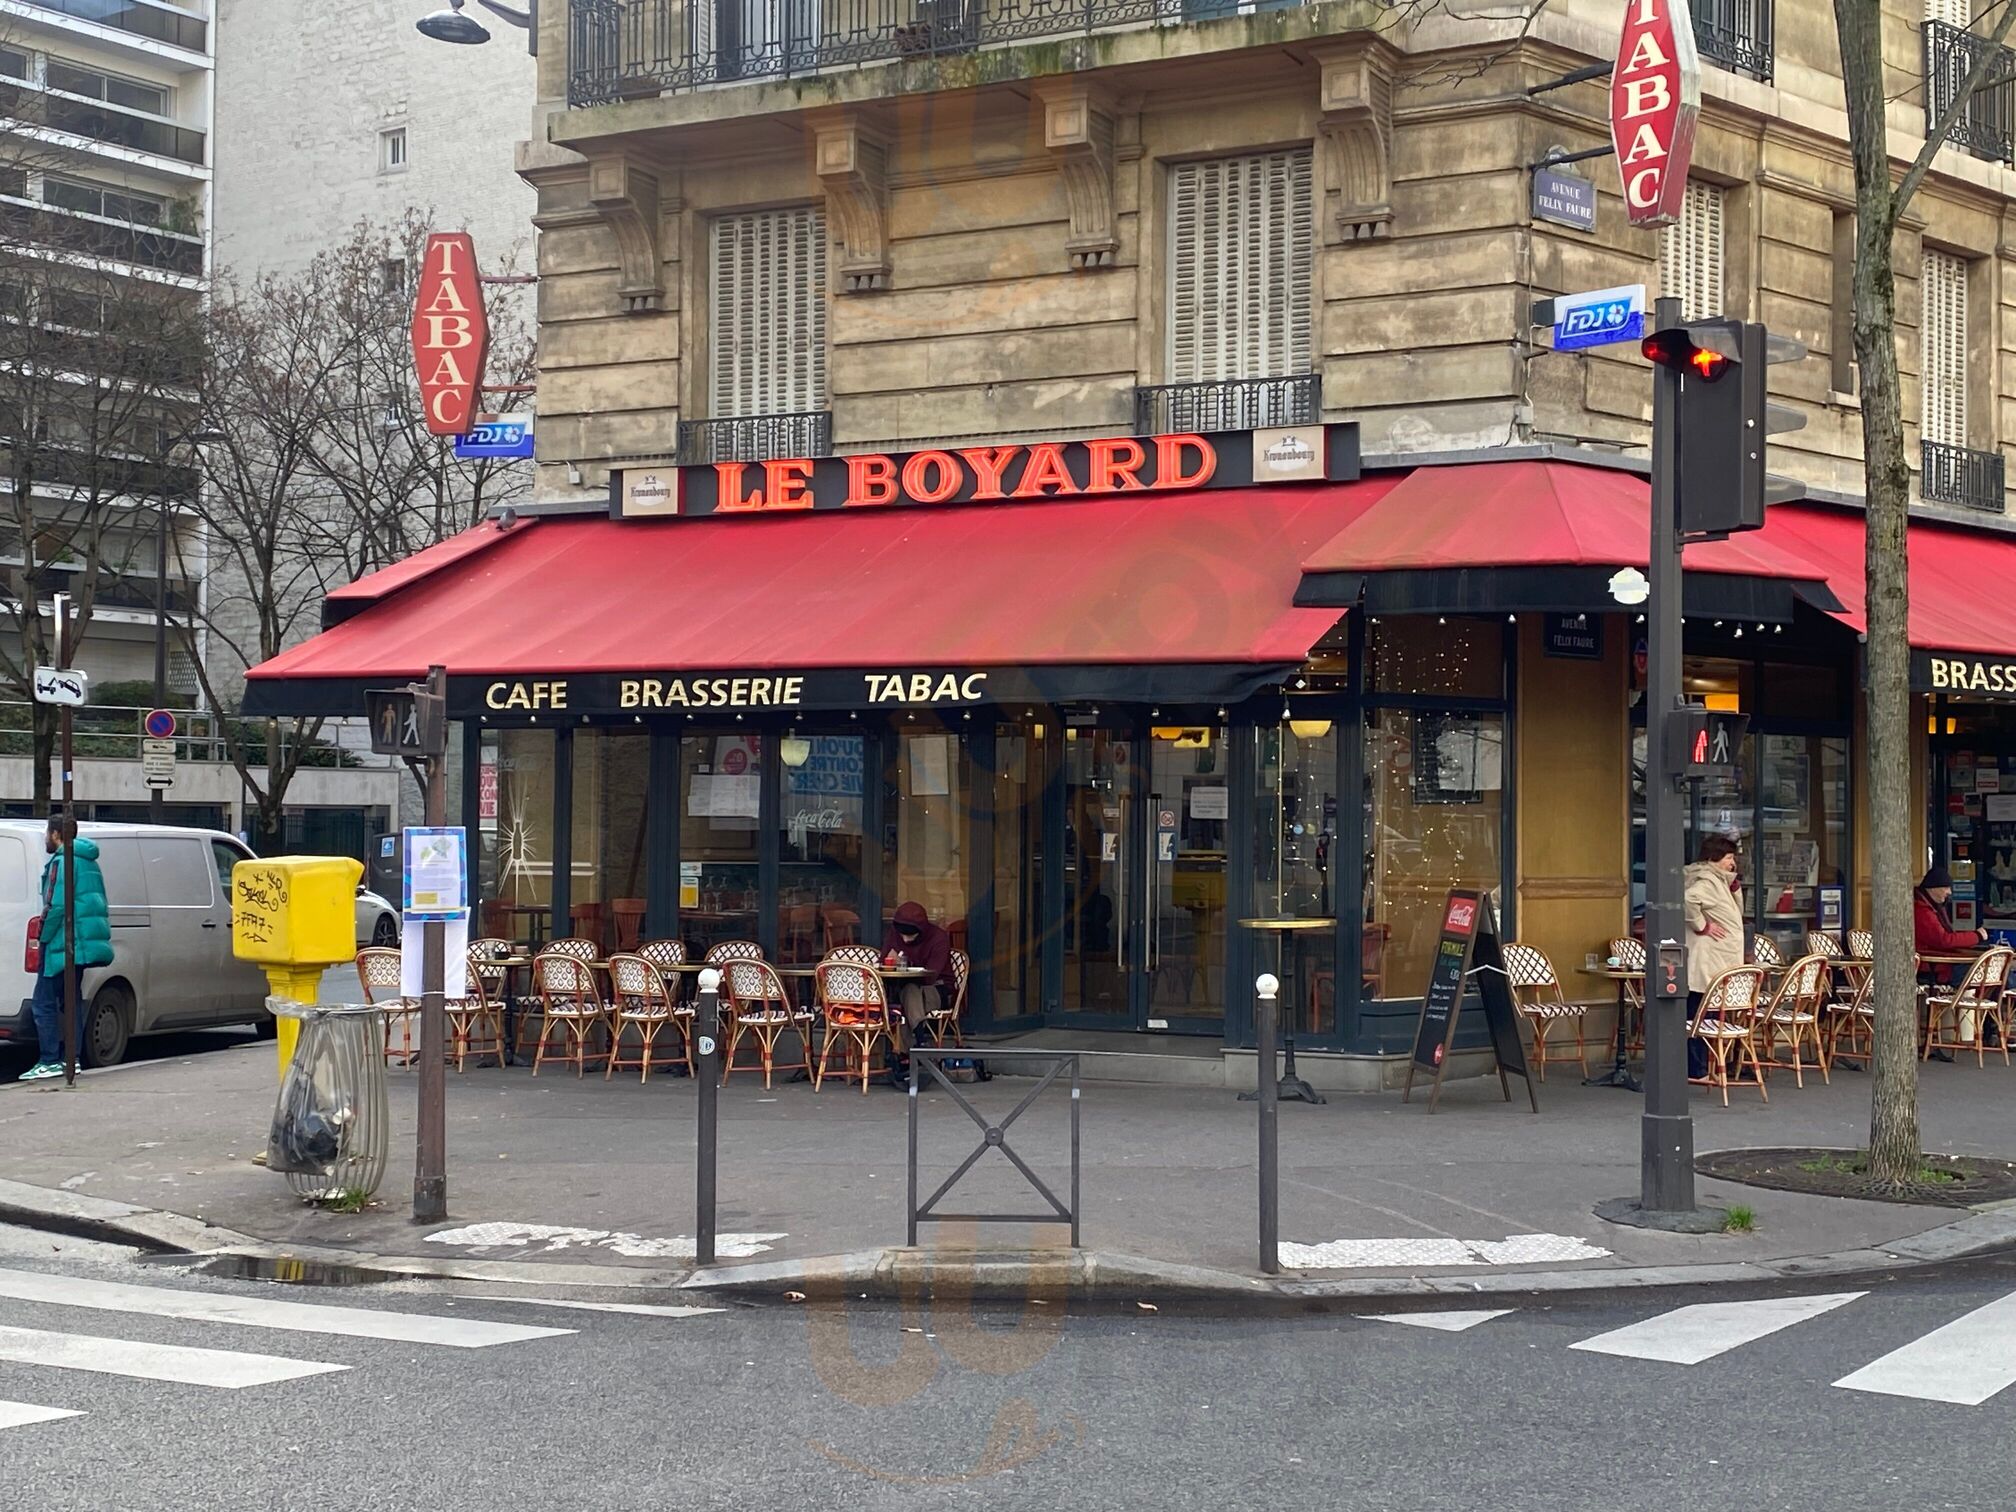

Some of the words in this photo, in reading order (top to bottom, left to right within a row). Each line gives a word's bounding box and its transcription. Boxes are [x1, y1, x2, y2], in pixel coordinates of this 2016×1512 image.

[1551, 182, 1580, 199] AVENUE
[1566, 203, 1592, 219] FAURE
[1567, 307, 1605, 332] FDJ
[422, 240, 473, 424] TABAC
[467, 426, 502, 443] FDJ
[714, 460, 814, 512] LE
[842, 436, 1217, 506] BOYARD
[1560, 618, 1588, 630] AVENUE
[1573, 636, 1594, 648] FAURE
[1931, 658, 2016, 692] BRASS
[486, 681, 567, 709] CAFE
[620, 677, 803, 707] BRASSERIE
[864, 673, 987, 703] TABAC
